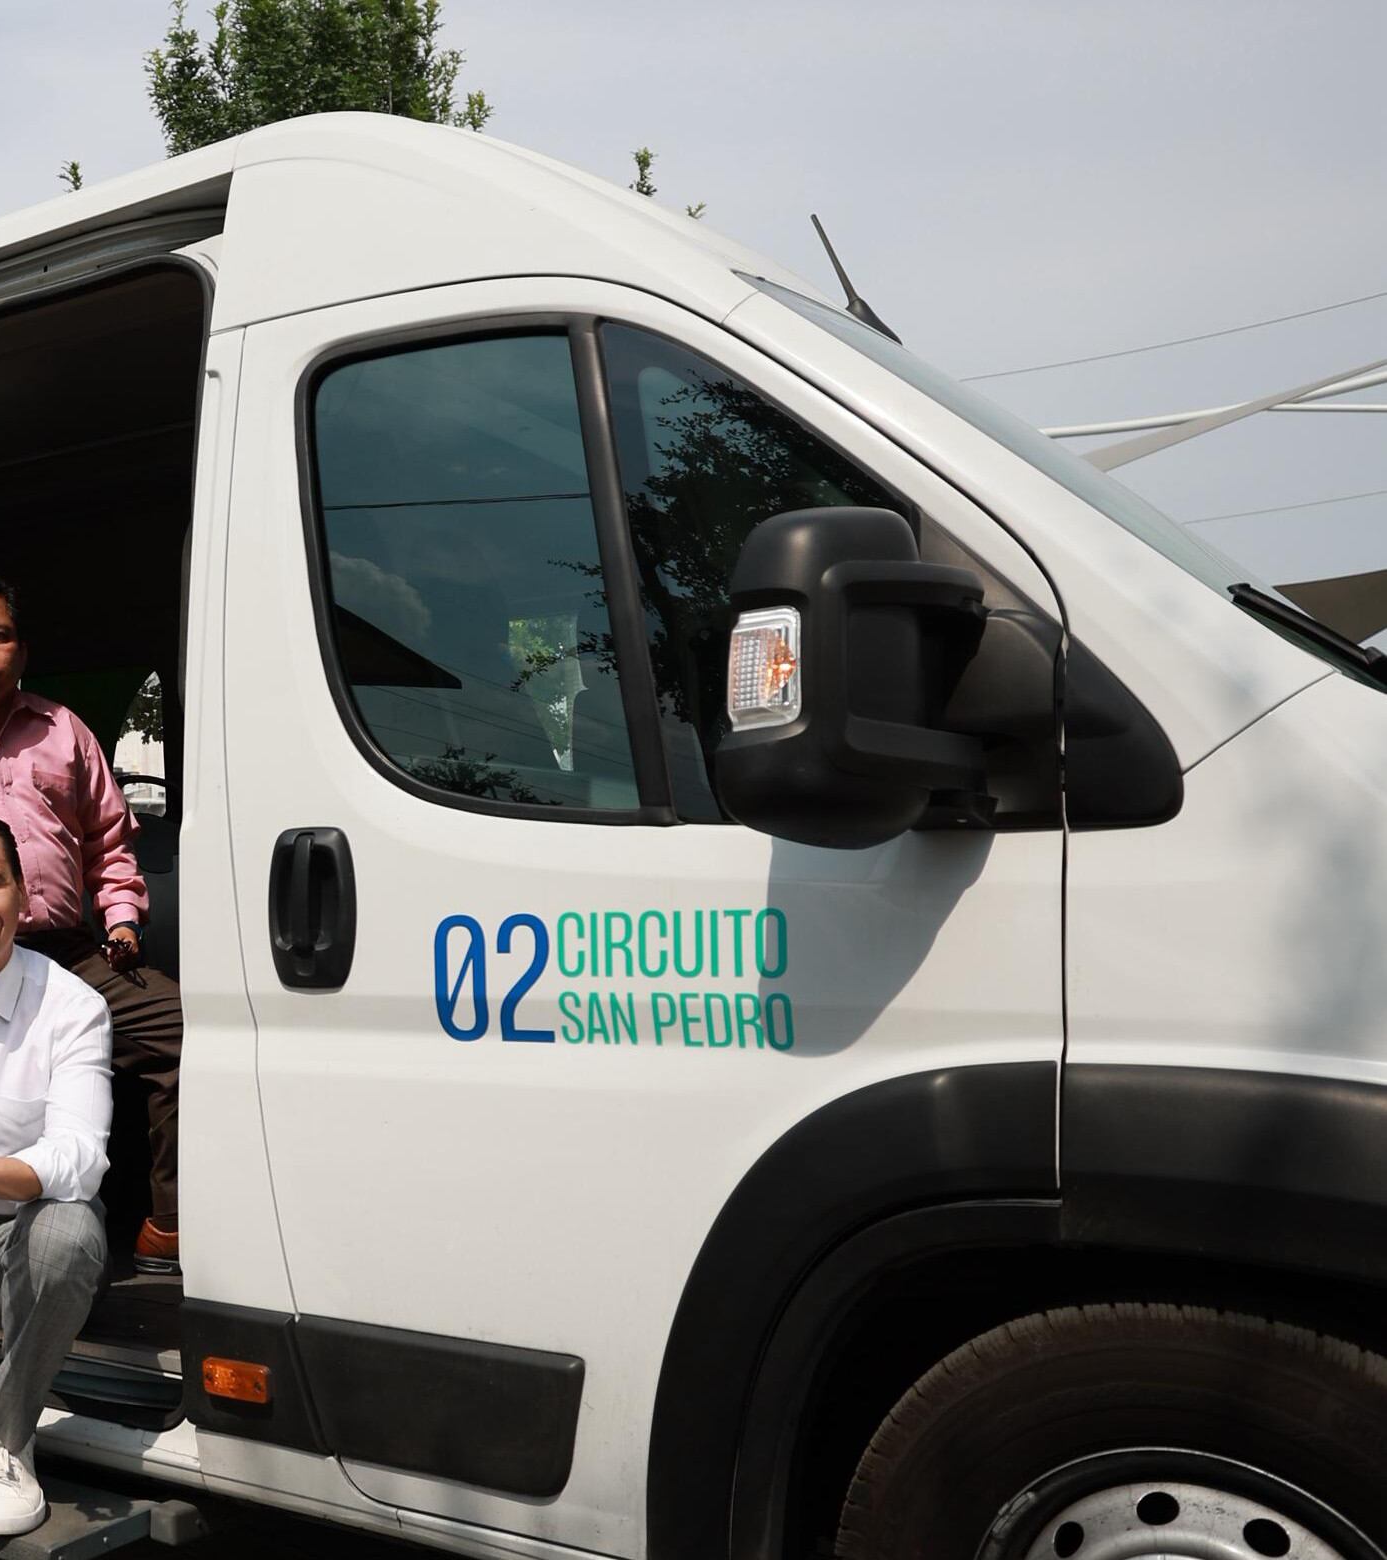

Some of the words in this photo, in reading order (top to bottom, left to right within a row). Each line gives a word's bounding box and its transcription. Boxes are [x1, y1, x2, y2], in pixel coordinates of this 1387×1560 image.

[433, 913, 556, 1043] 02
[557, 907, 788, 978] CIRCUITO
[560, 991, 639, 1046] SAN
[652, 992, 795, 1051] PEDRO
